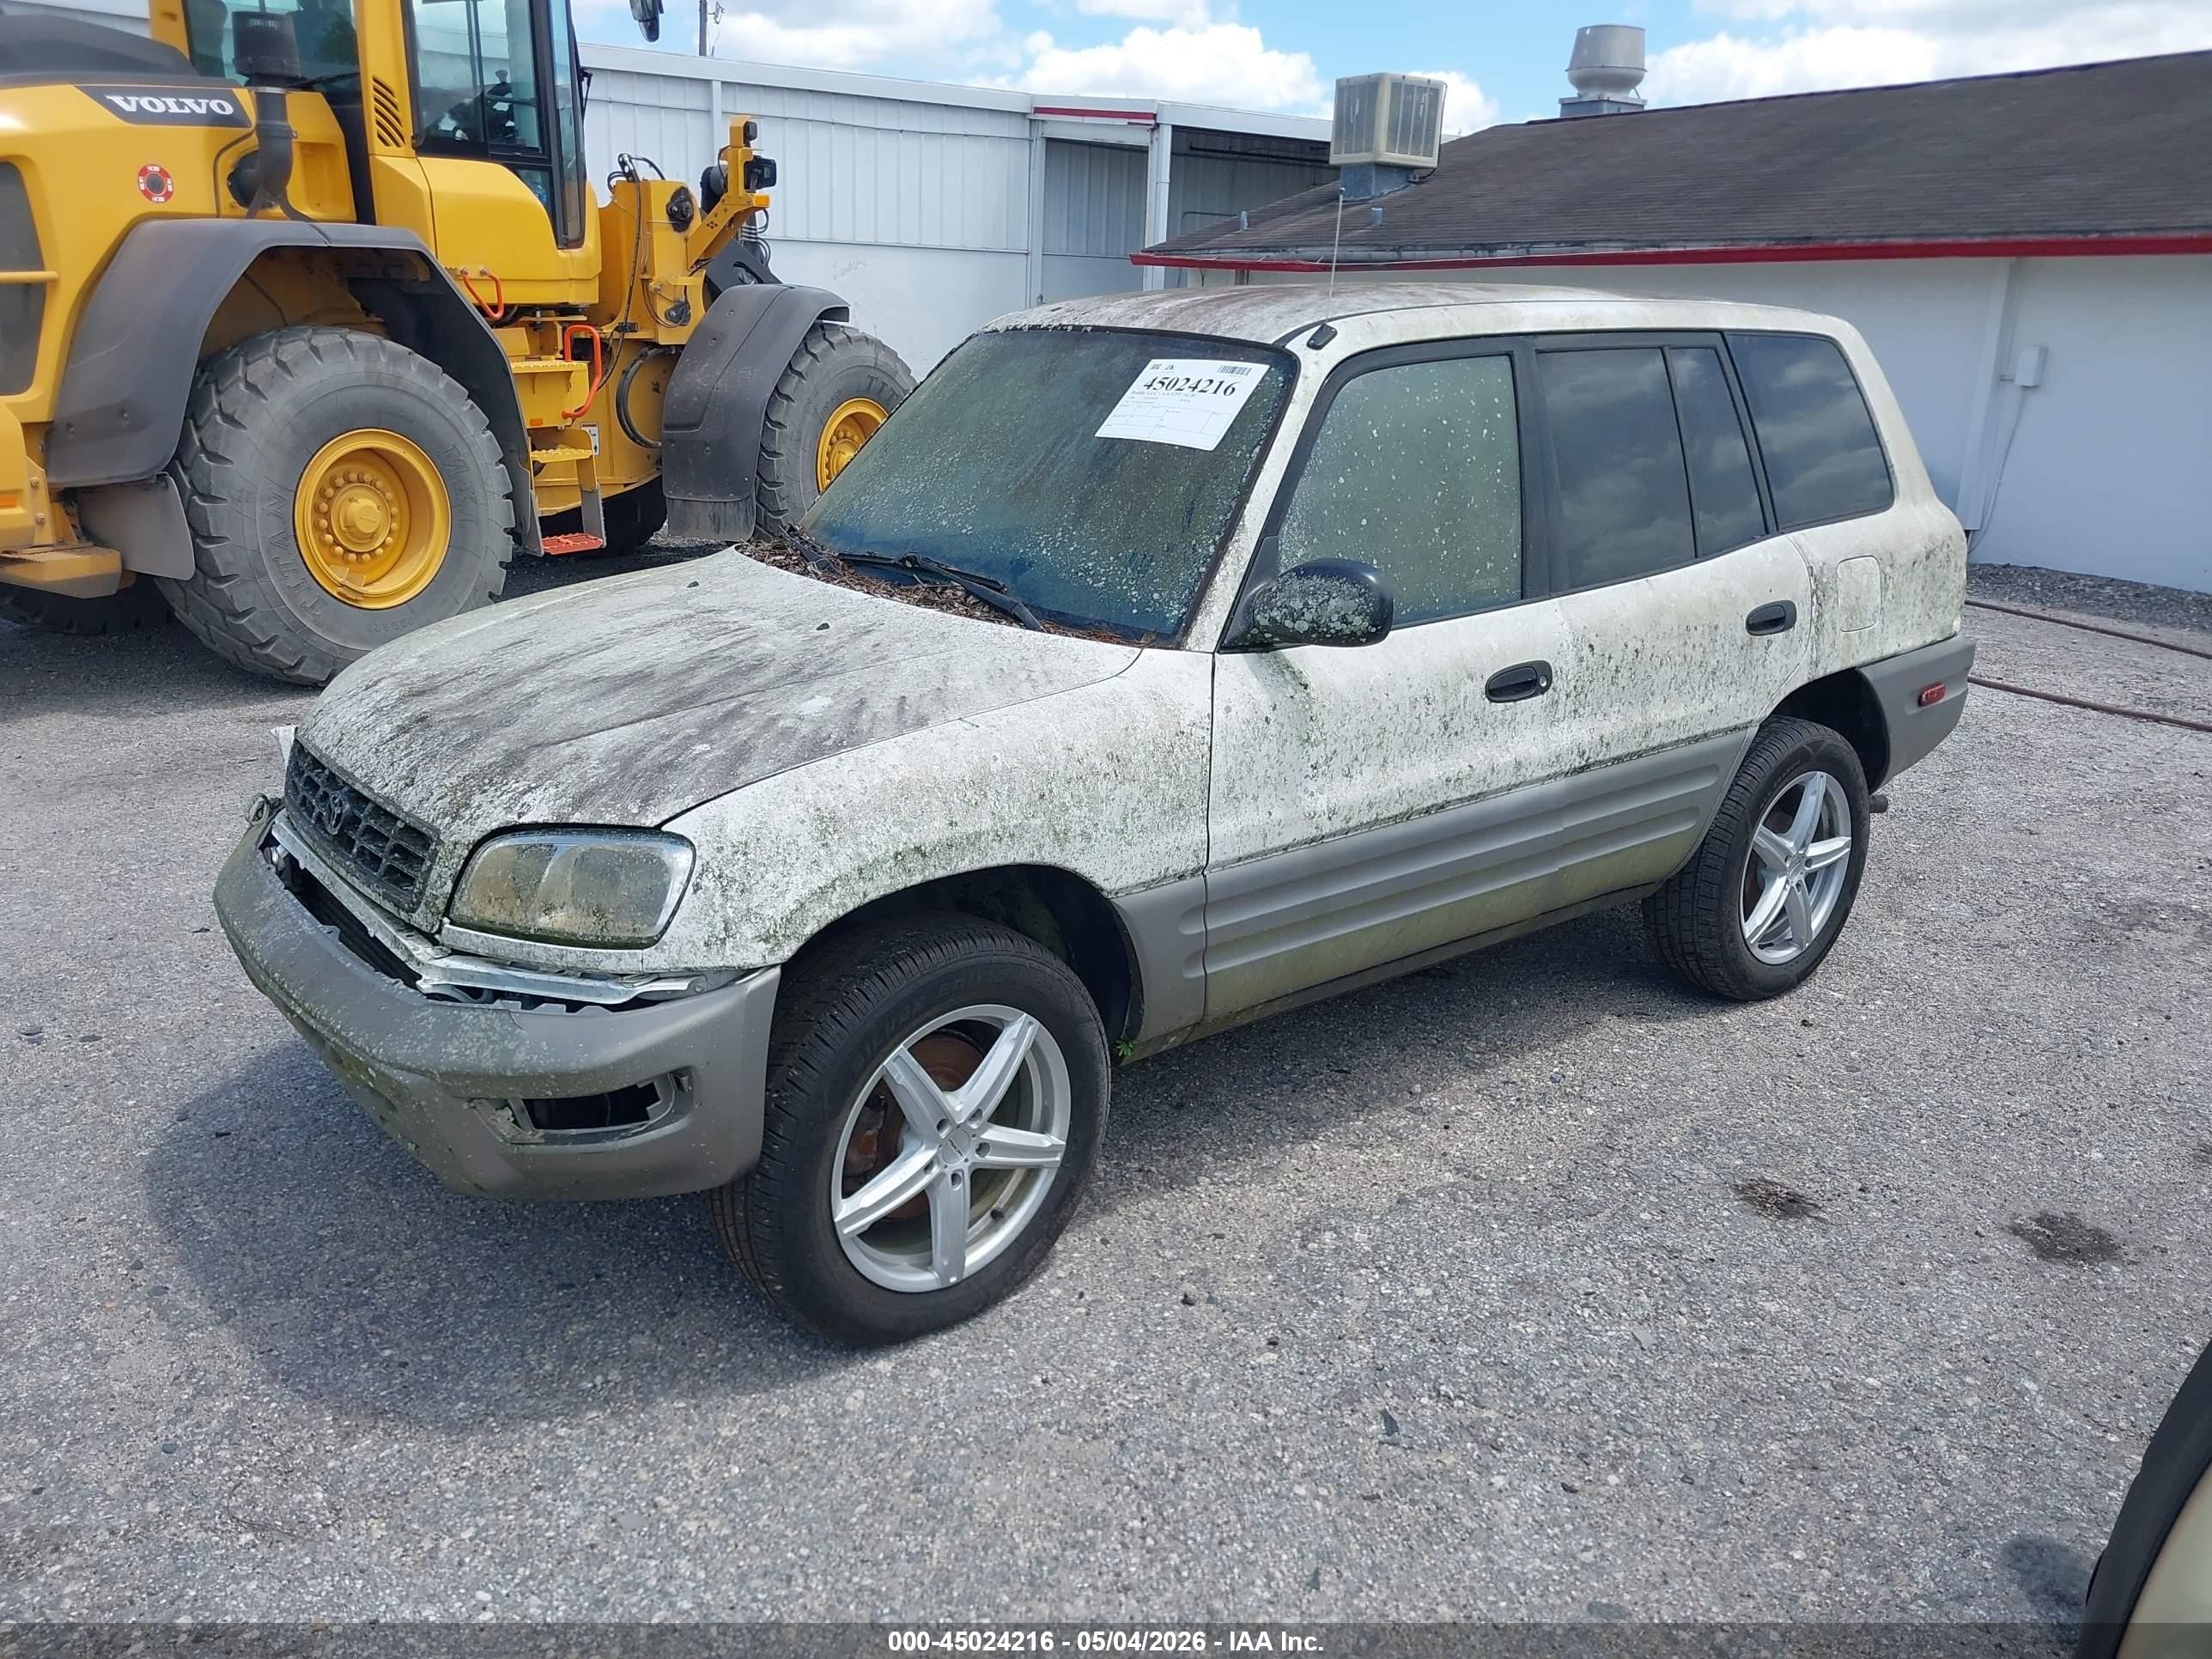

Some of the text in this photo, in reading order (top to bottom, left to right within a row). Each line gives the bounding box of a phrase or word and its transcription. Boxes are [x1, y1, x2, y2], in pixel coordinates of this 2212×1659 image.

[104, 94, 234, 115] VOLVO
[1143, 376, 1241, 397] 45024216
[267, 486, 327, 617] TITAN
